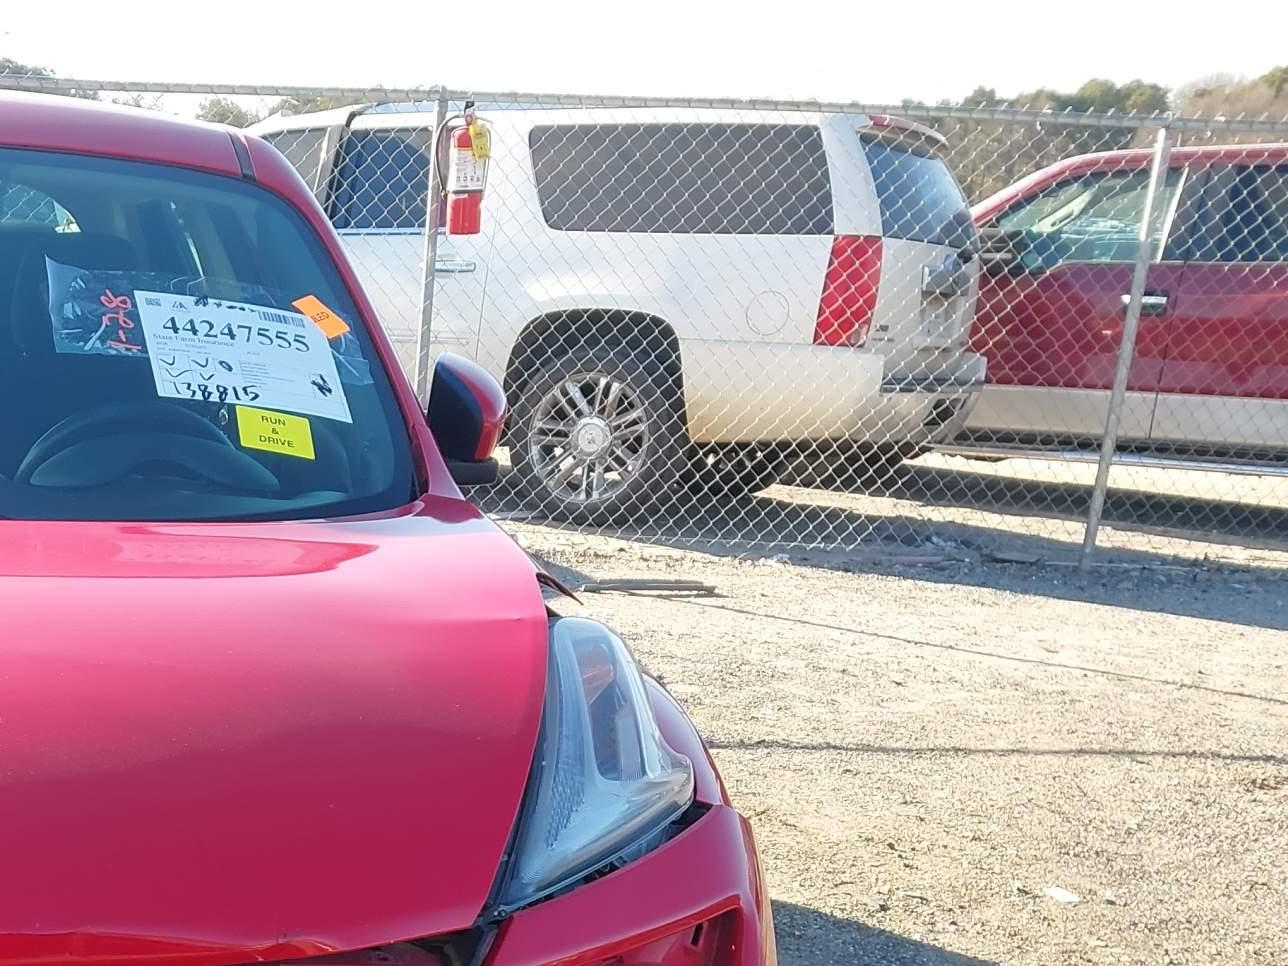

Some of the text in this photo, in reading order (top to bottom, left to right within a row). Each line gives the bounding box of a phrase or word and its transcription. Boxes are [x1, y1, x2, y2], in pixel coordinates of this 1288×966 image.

[162, 316, 310, 353] 44247555
[173, 382, 260, 402] 138815
[260, 415, 286, 426] RUN
[258, 435, 295, 448] DRIVE
